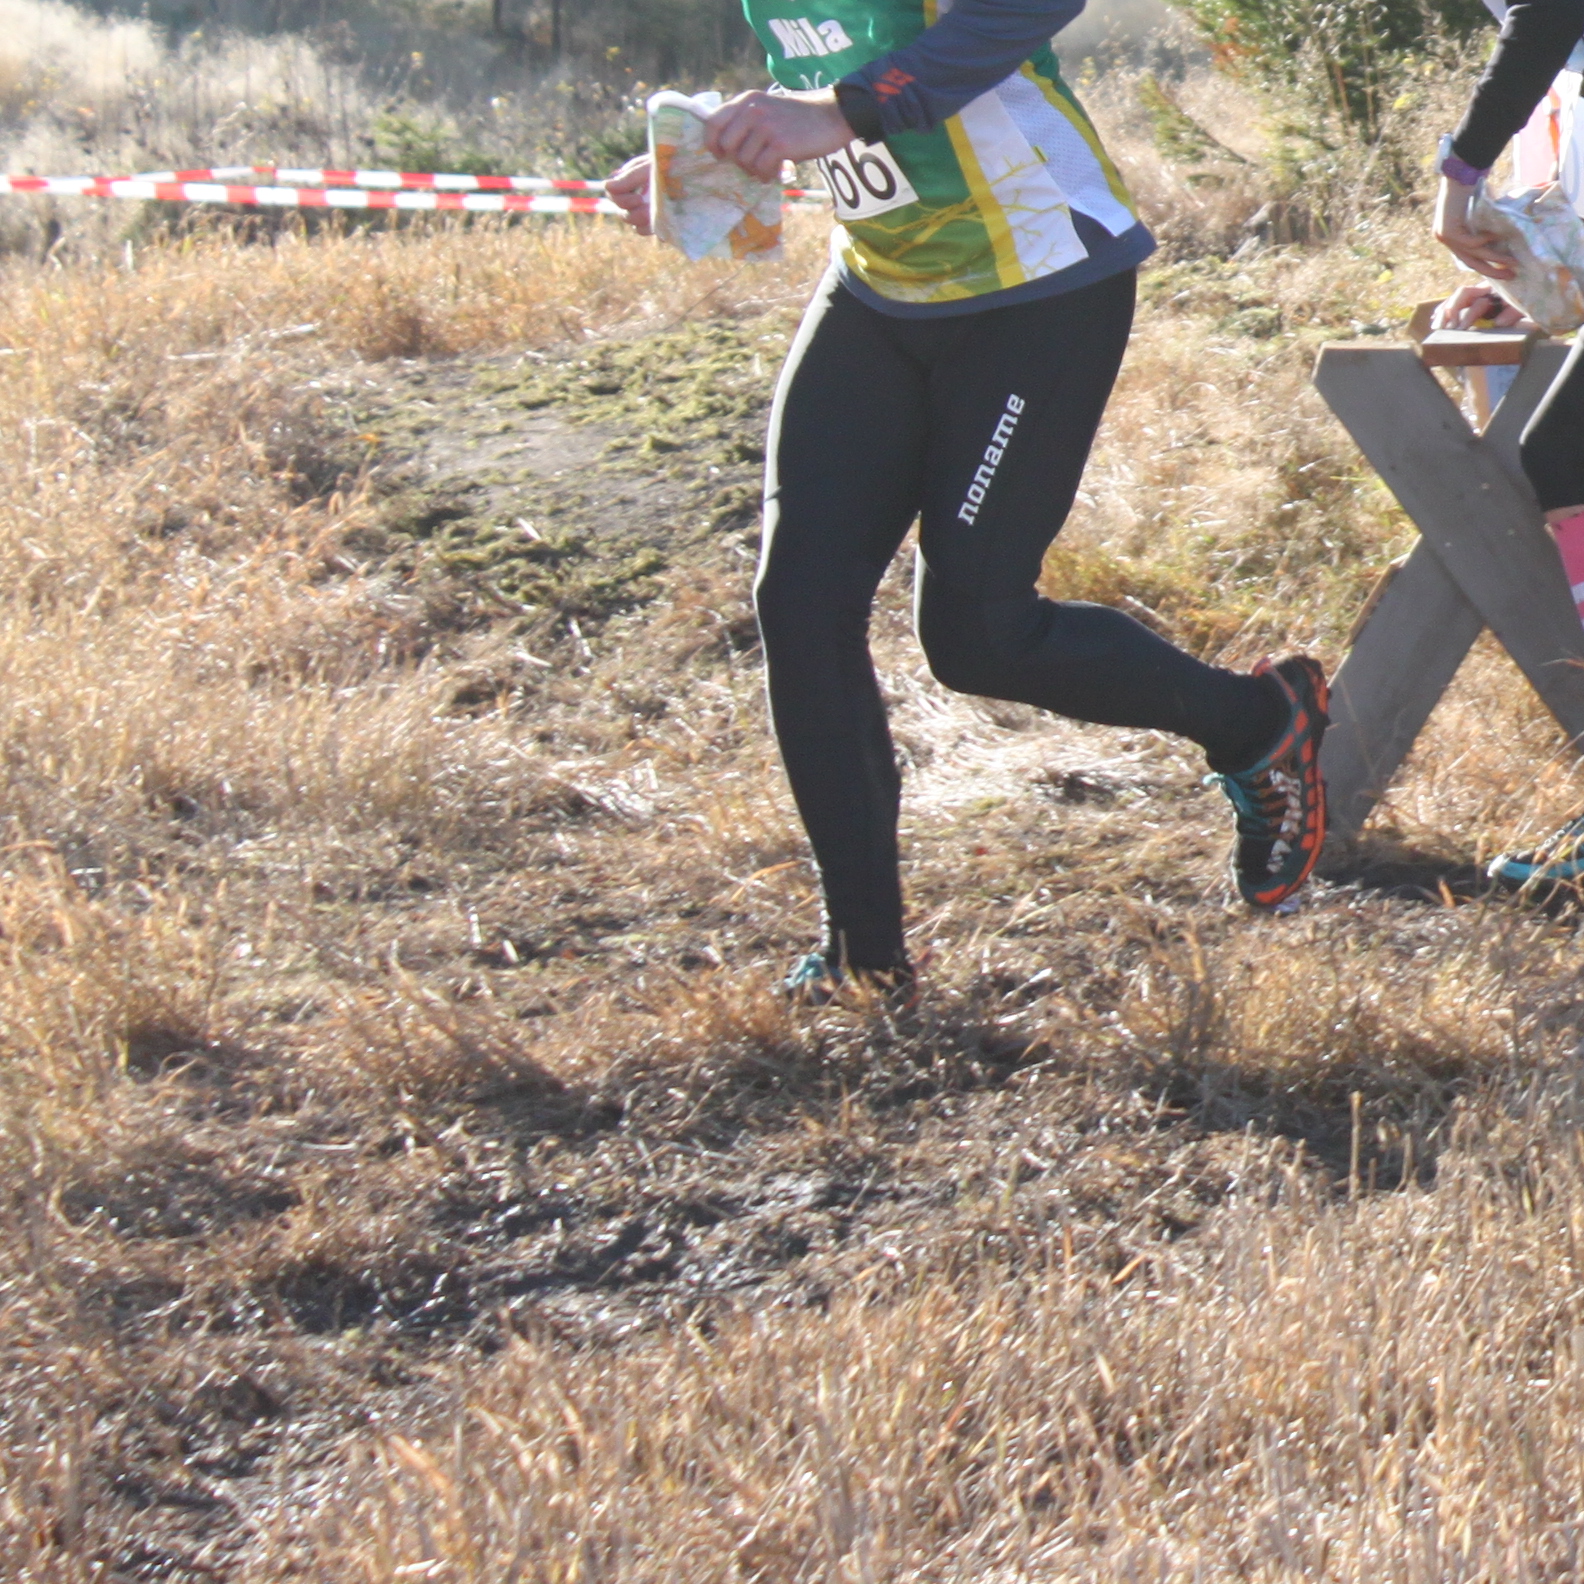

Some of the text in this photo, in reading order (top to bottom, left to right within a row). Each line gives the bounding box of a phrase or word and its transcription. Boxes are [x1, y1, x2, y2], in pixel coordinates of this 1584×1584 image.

[768, 17, 853, 60] Mila
[816, 142, 898, 210] 66
[957, 393, 1026, 527] noname
